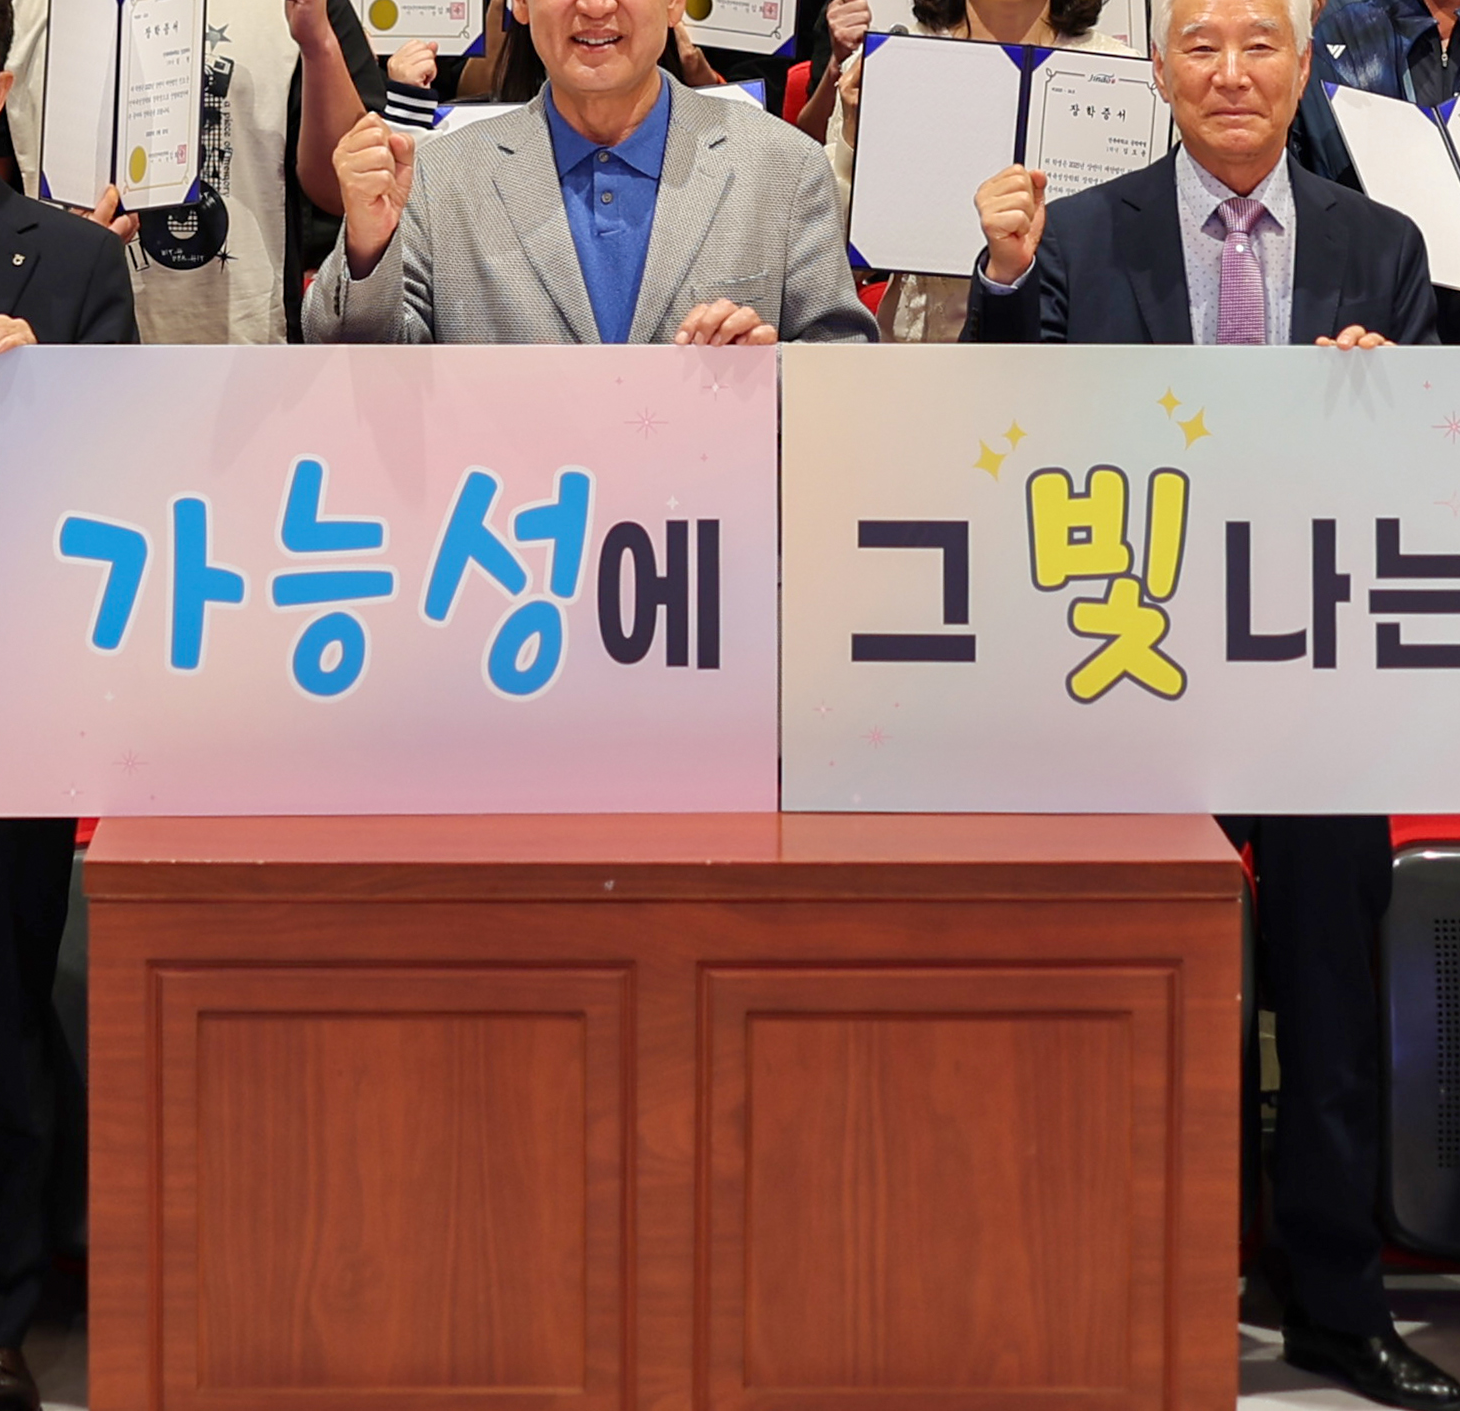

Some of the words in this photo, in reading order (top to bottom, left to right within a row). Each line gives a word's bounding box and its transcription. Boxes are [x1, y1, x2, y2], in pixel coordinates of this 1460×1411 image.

[1088, 73, 1113, 85] Jindo
[224, 100, 231, 108] a
[1070, 103, 1127, 123] 장학증서
[222, 112, 233, 138] piece
[57, 454, 721, 701] 가능성에
[850, 519, 977, 664] 그
